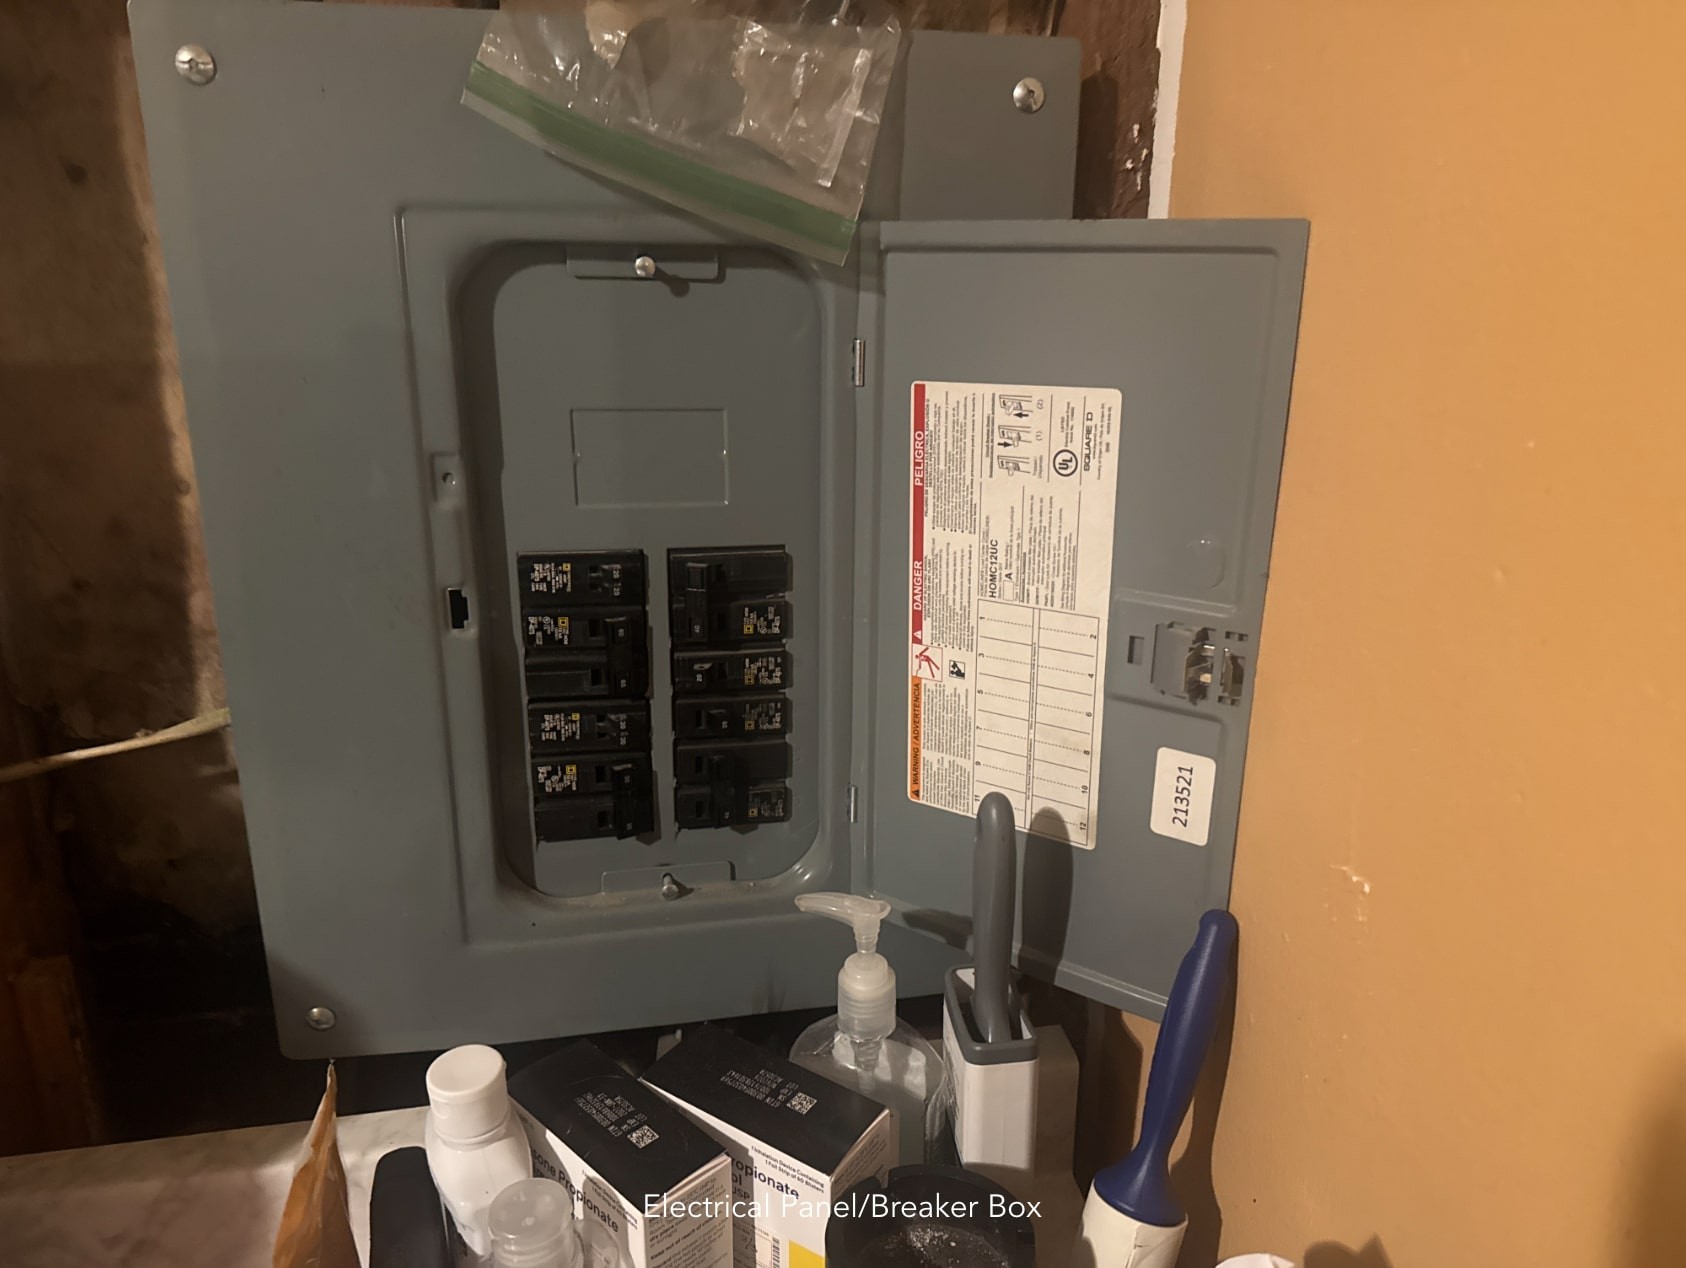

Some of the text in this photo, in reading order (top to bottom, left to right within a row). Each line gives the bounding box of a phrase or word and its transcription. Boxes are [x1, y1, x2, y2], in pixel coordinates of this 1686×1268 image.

[1036, 398, 1044, 410] (2)
[1035, 430, 1043, 441] (1)
[1084, 412, 1093, 472] SQUARE D
[915, 431, 924, 486] PELIGRO
[1058, 457, 1072, 470] UL
[989, 540, 998, 598] HOMC12UC
[1005, 572, 1012, 580] A
[914, 560, 922, 611] DANGER
[694, 625, 700, 633] 40
[696, 674, 703, 682] 20
[1082, 786, 1088, 794] 10
[975, 794, 980, 802] 11
[1172, 766, 1193, 828] 213521
[1080, 822, 1086, 830] 12
[763, 1096, 781, 1108] GTIN
[754, 1146, 778, 1163] Inhalation
[779, 1159, 795, 1173] Device
[796, 1168, 824, 1188] Containing
[732, 1156, 799, 1199] ropionate
[768, 1160, 776, 1169] Foil
[778, 1165, 789, 1177] Strip
[804, 1180, 824, 1194] Blisters
[558, 1170, 620, 1233] Propionate
